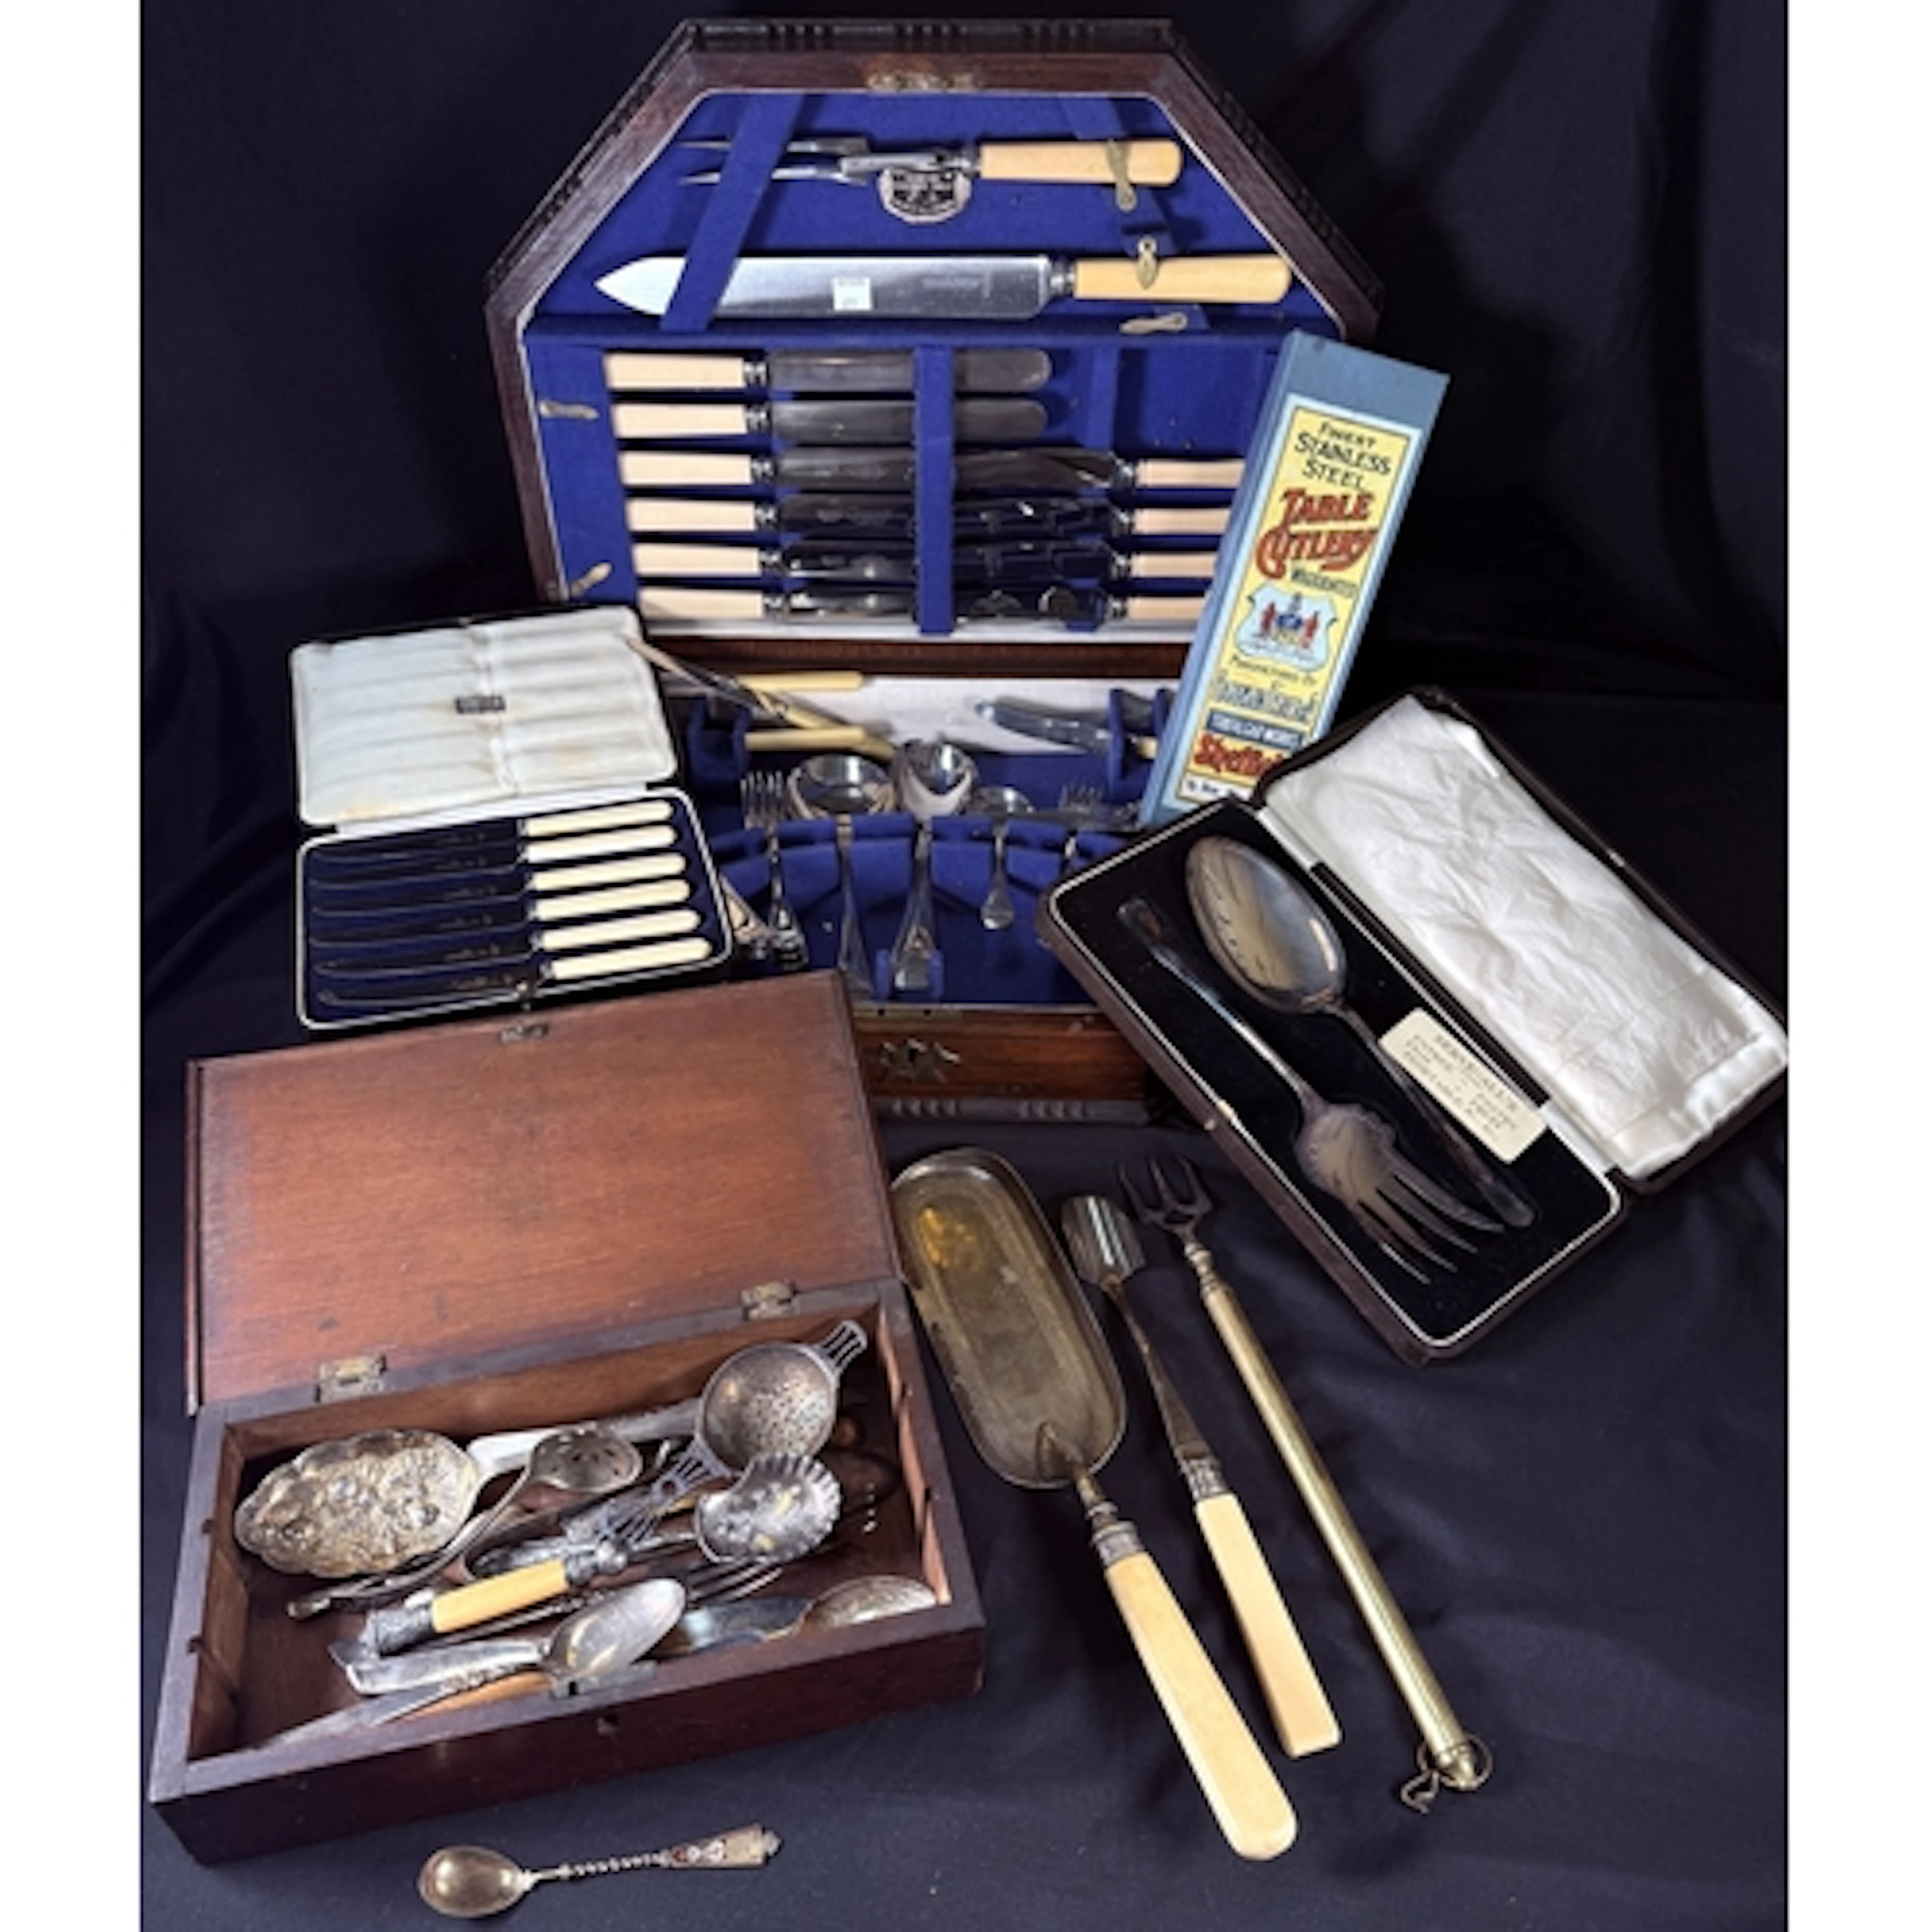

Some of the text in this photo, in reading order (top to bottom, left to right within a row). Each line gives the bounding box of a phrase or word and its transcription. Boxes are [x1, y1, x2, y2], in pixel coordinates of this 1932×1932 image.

[1295, 431, 1392, 475] STAINLESS
[1302, 458, 1365, 489] STEEL
[1280, 487, 1376, 527] TABLE
